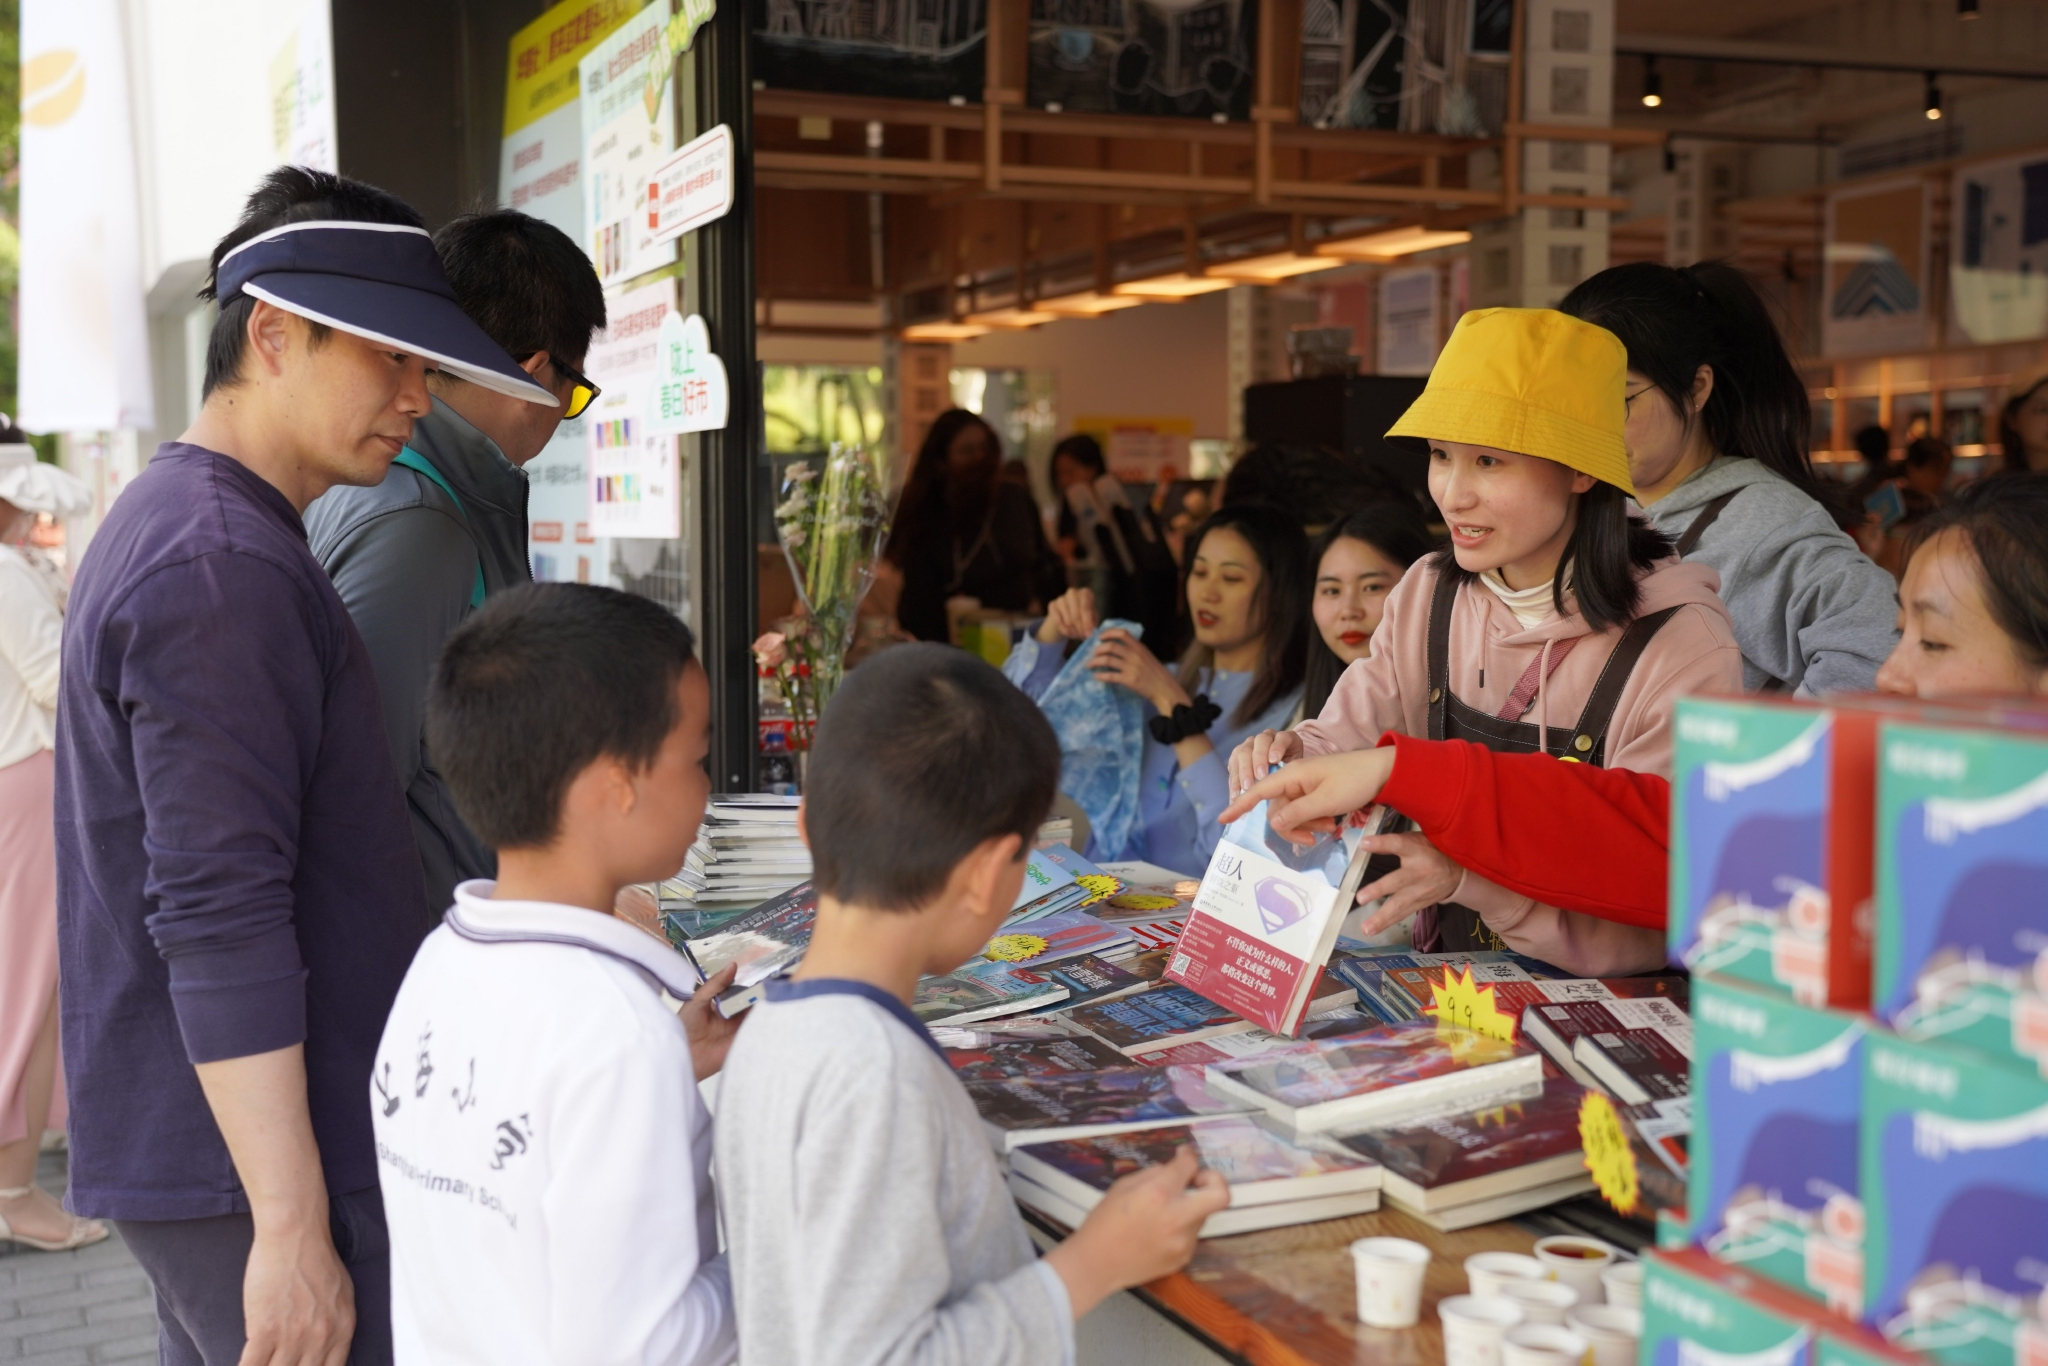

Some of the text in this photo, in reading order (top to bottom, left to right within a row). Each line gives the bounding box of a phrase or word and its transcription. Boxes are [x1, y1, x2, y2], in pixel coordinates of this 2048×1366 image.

[1213, 852, 1243, 881] 超人
[1095, 999, 1171, 1037] 美国队长
[1141, 992, 1210, 1026] AMERICA
